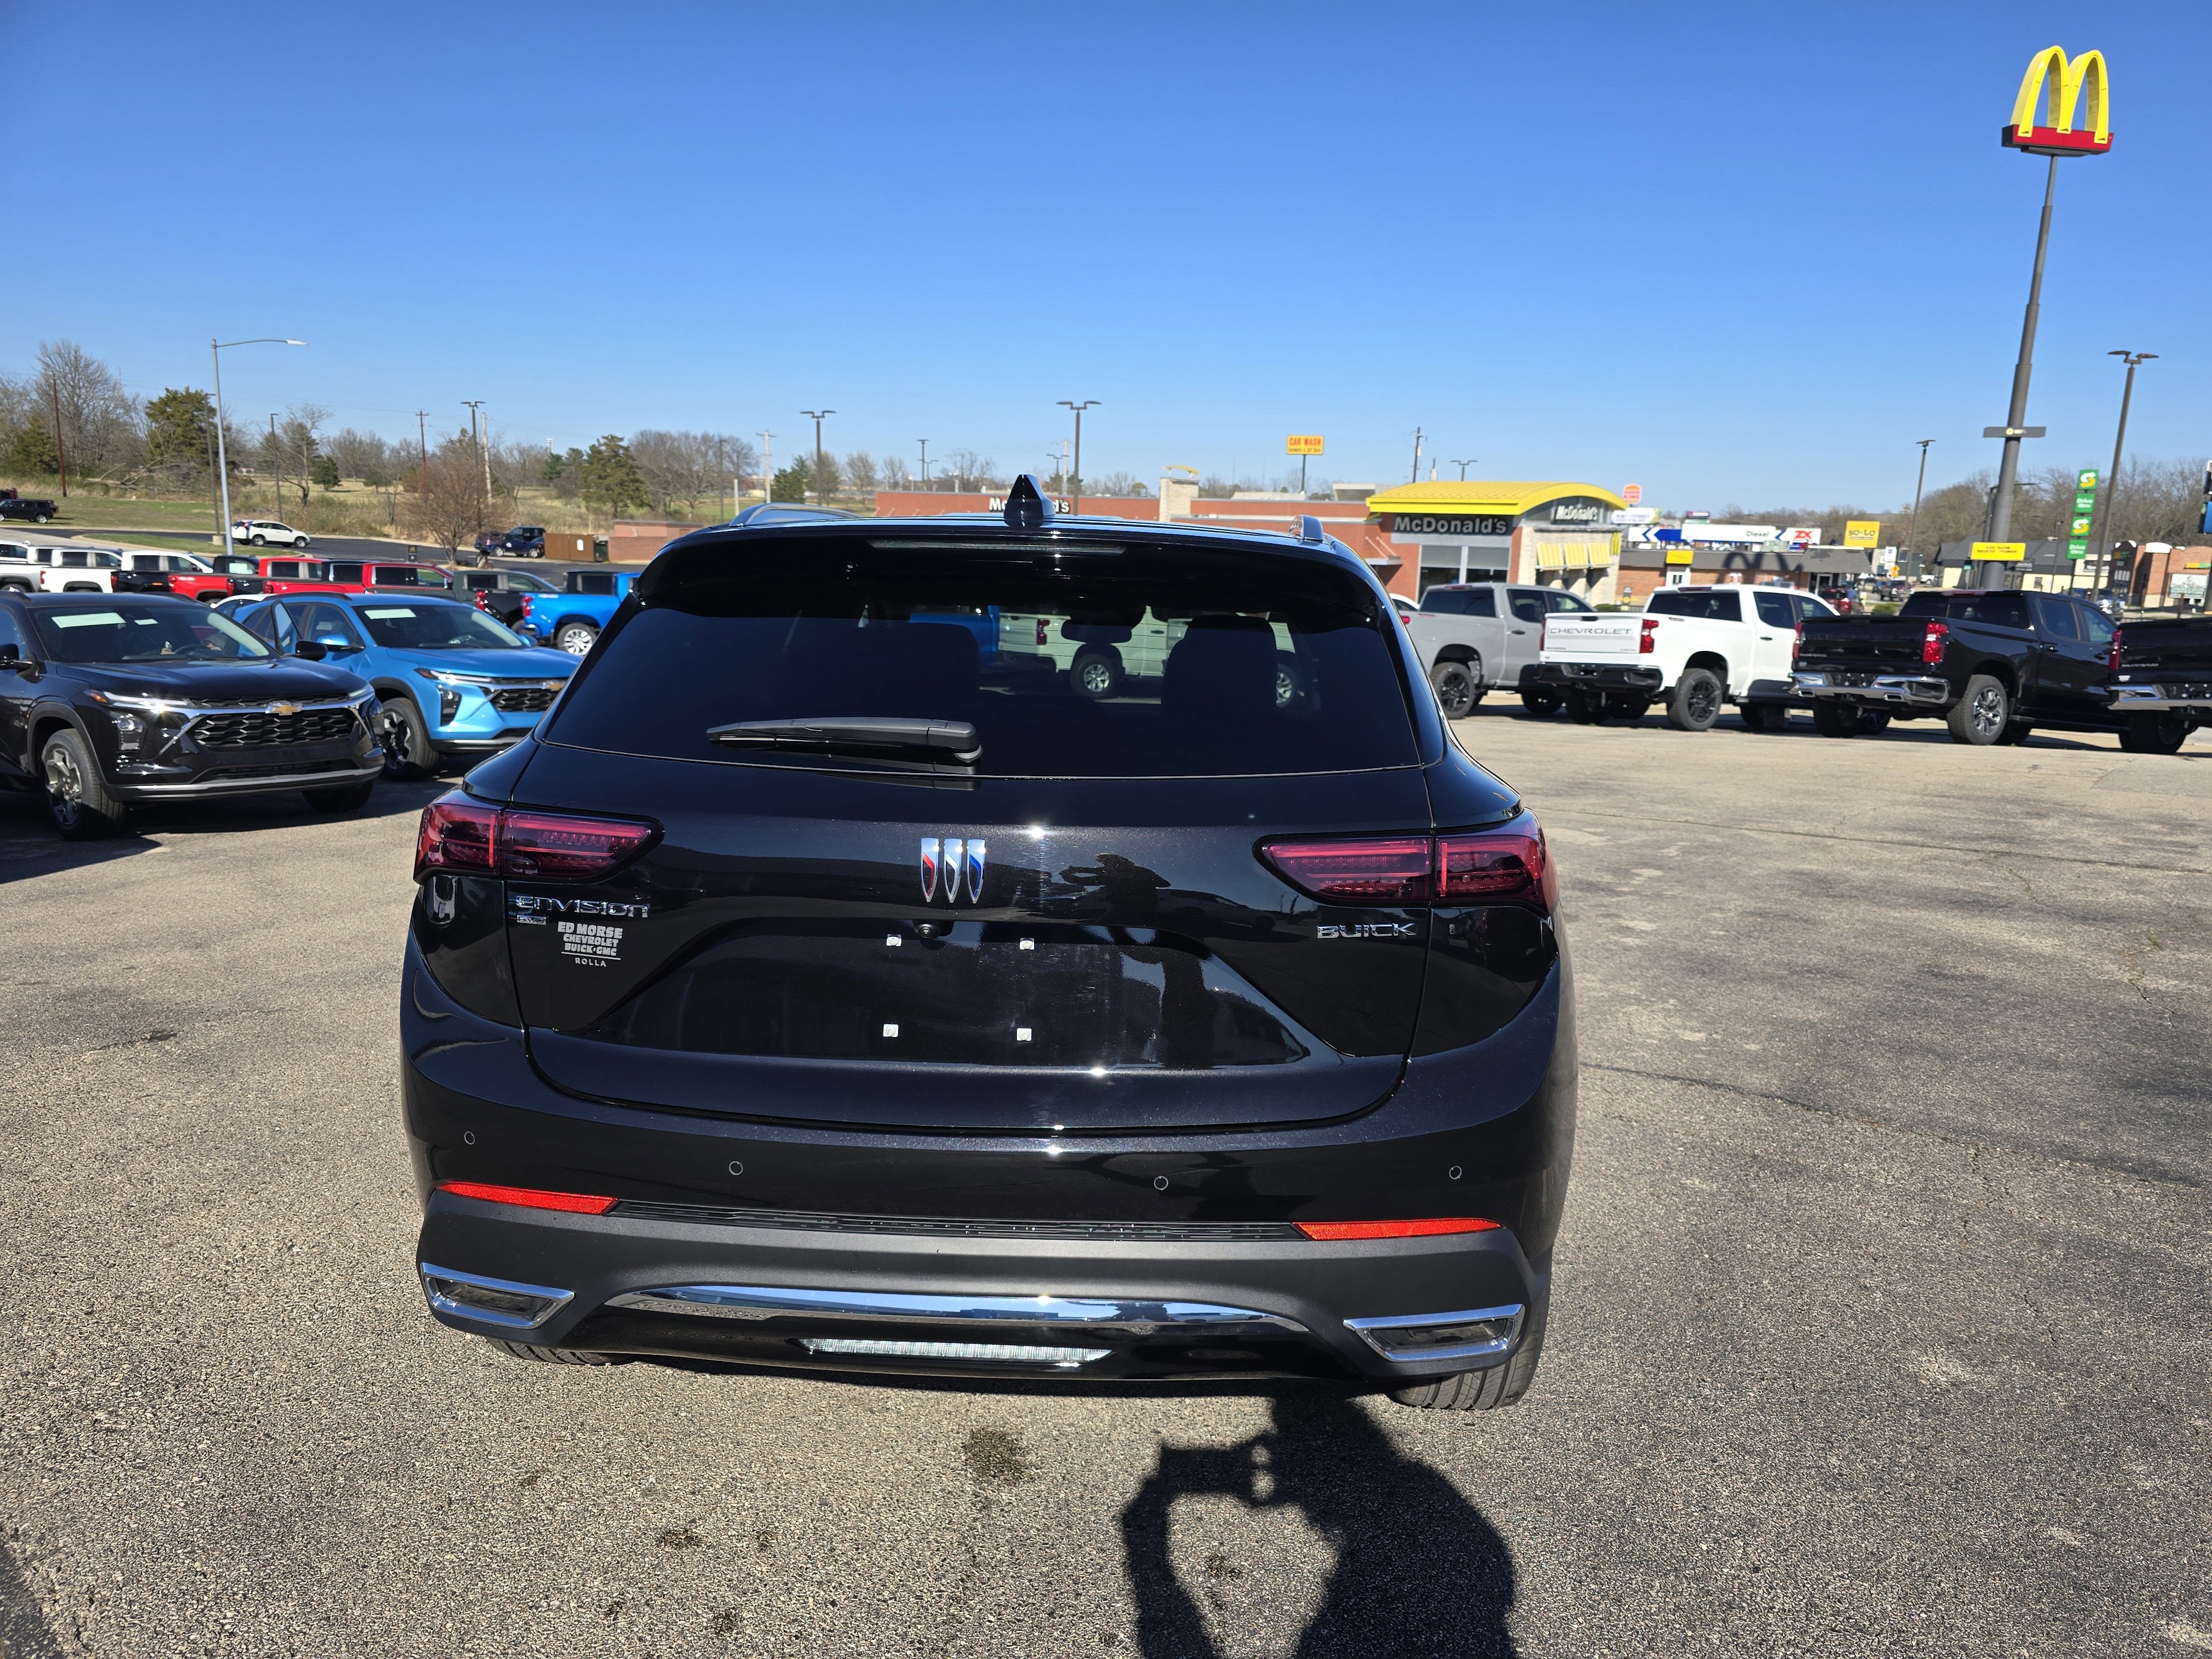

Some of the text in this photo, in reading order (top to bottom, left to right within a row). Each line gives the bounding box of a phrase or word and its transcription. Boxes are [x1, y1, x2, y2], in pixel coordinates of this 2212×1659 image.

[1556, 505, 1598, 520] McDonald's
[1394, 517, 1507, 534] McDonald's
[516, 896, 650, 918] ENVISION
[557, 921, 623, 939] ED MORSE
[1317, 923, 1417, 939] BUICK
[563, 933, 619, 947] CHEVROLET
[575, 957, 607, 967] ROLLA
